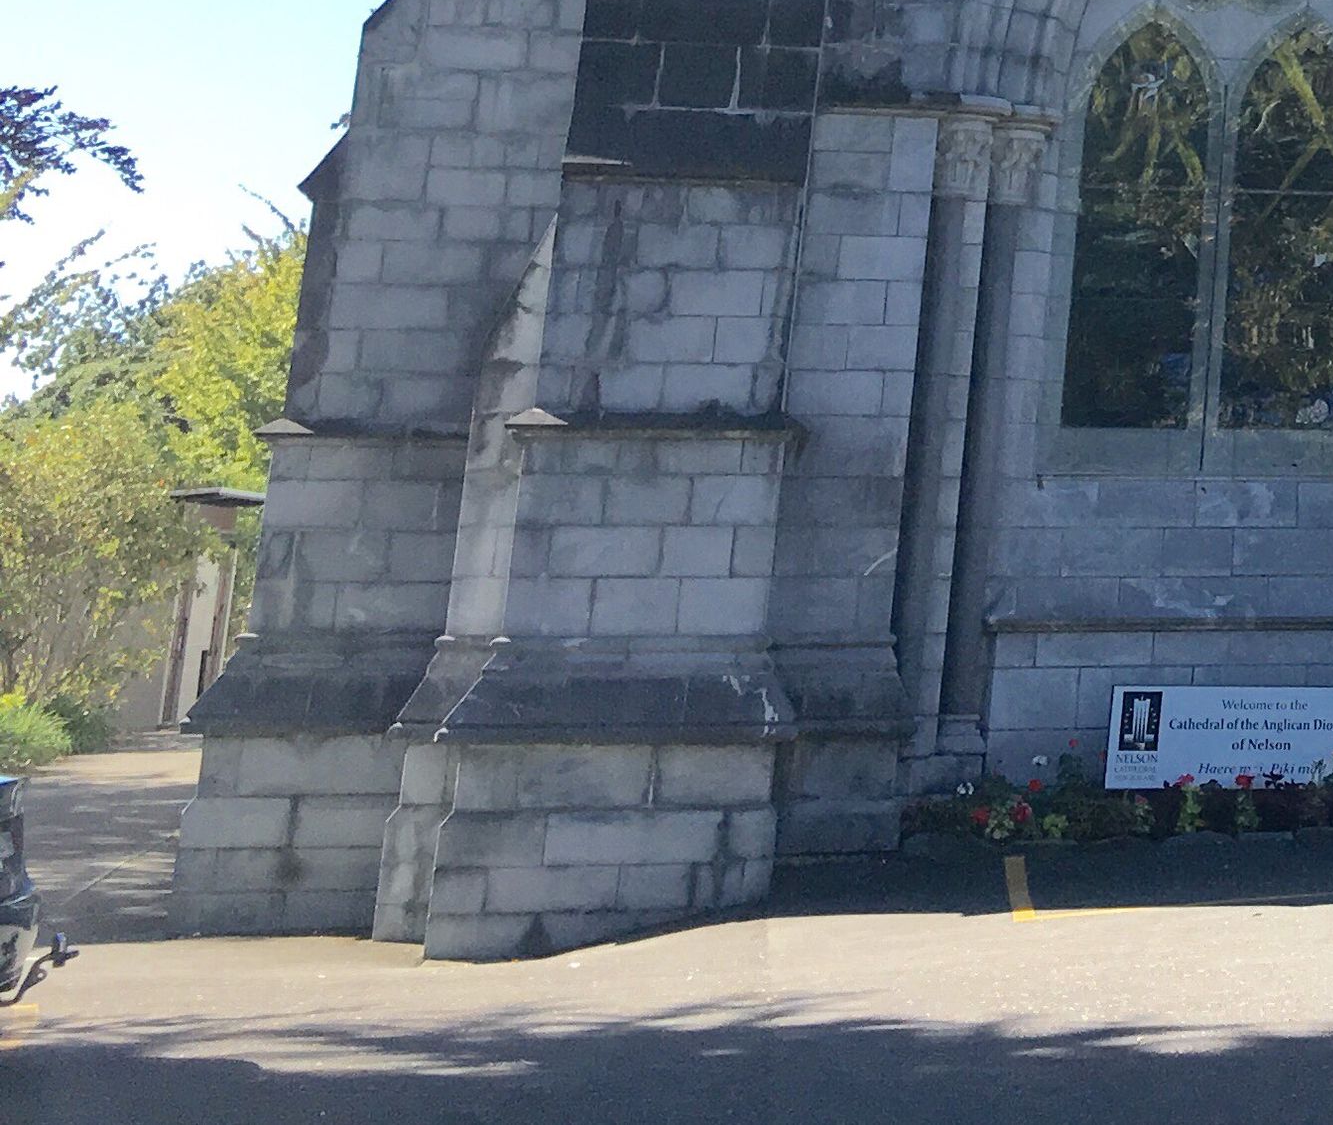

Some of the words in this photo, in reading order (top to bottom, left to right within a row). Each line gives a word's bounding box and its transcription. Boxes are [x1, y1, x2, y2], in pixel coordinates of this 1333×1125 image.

[1222, 699, 1273, 711] Welcome
[1276, 701, 1288, 711] to
[1290, 699, 1308, 711] the
[1168, 718, 1225, 731] Cathedral
[1227, 718, 1240, 731] of
[1240, 719, 1259, 731] the
[1261, 719, 1311, 733] Anglican
[1231, 738, 1246, 751] of
[1249, 738, 1291, 751] Nelson
[1116, 754, 1158, 763] NELSON
[1198, 763, 1235, 774] Haere
